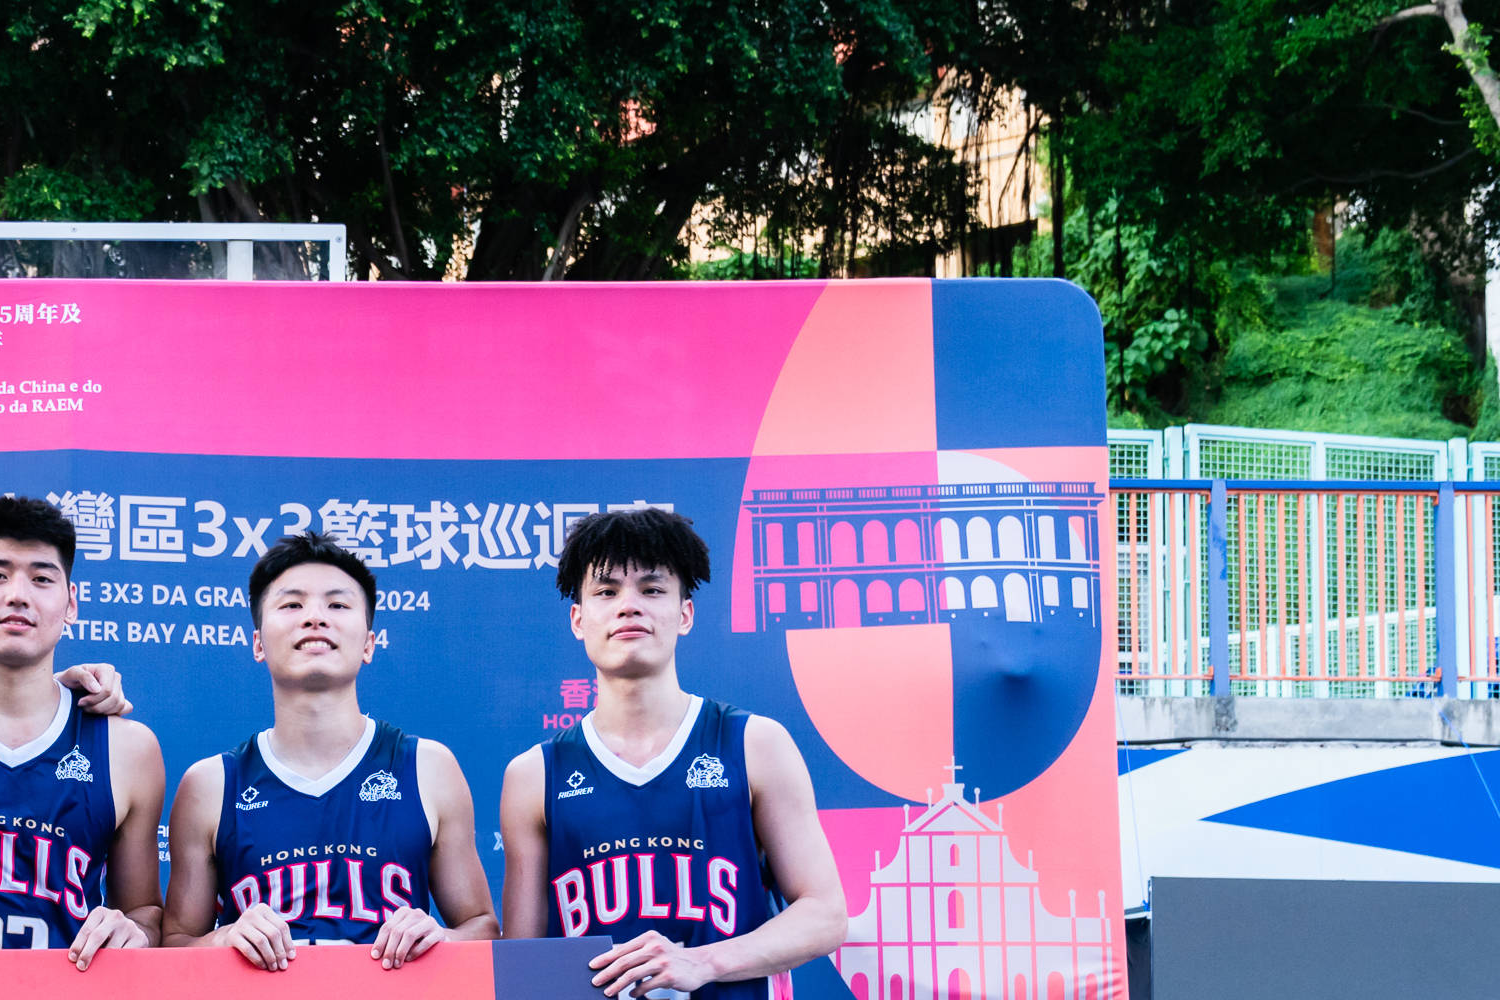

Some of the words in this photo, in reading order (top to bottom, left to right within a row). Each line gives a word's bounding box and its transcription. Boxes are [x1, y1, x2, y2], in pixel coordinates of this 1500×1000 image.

[20, 380, 65, 394] China
[32, 398, 83, 412] RAEM
[100, 583, 143, 604] 3X3
[152, 585, 188, 606] DA
[195, 586, 250, 608] GRA
[375, 590, 431, 612] 2024
[59, 619, 119, 642] ATER
[127, 622, 176, 645] BAY
[182, 624, 249, 647] AREA
[558, 786, 594, 800] RIGORER
[13, 817, 65, 837] KONG
[261, 846, 318, 866] HONG
[325, 844, 377, 857] KONG
[583, 837, 640, 859] HONG
[648, 836, 704, 850] KONG
[231, 857, 412, 923] BULLS
[551, 853, 739, 937] BULLS
